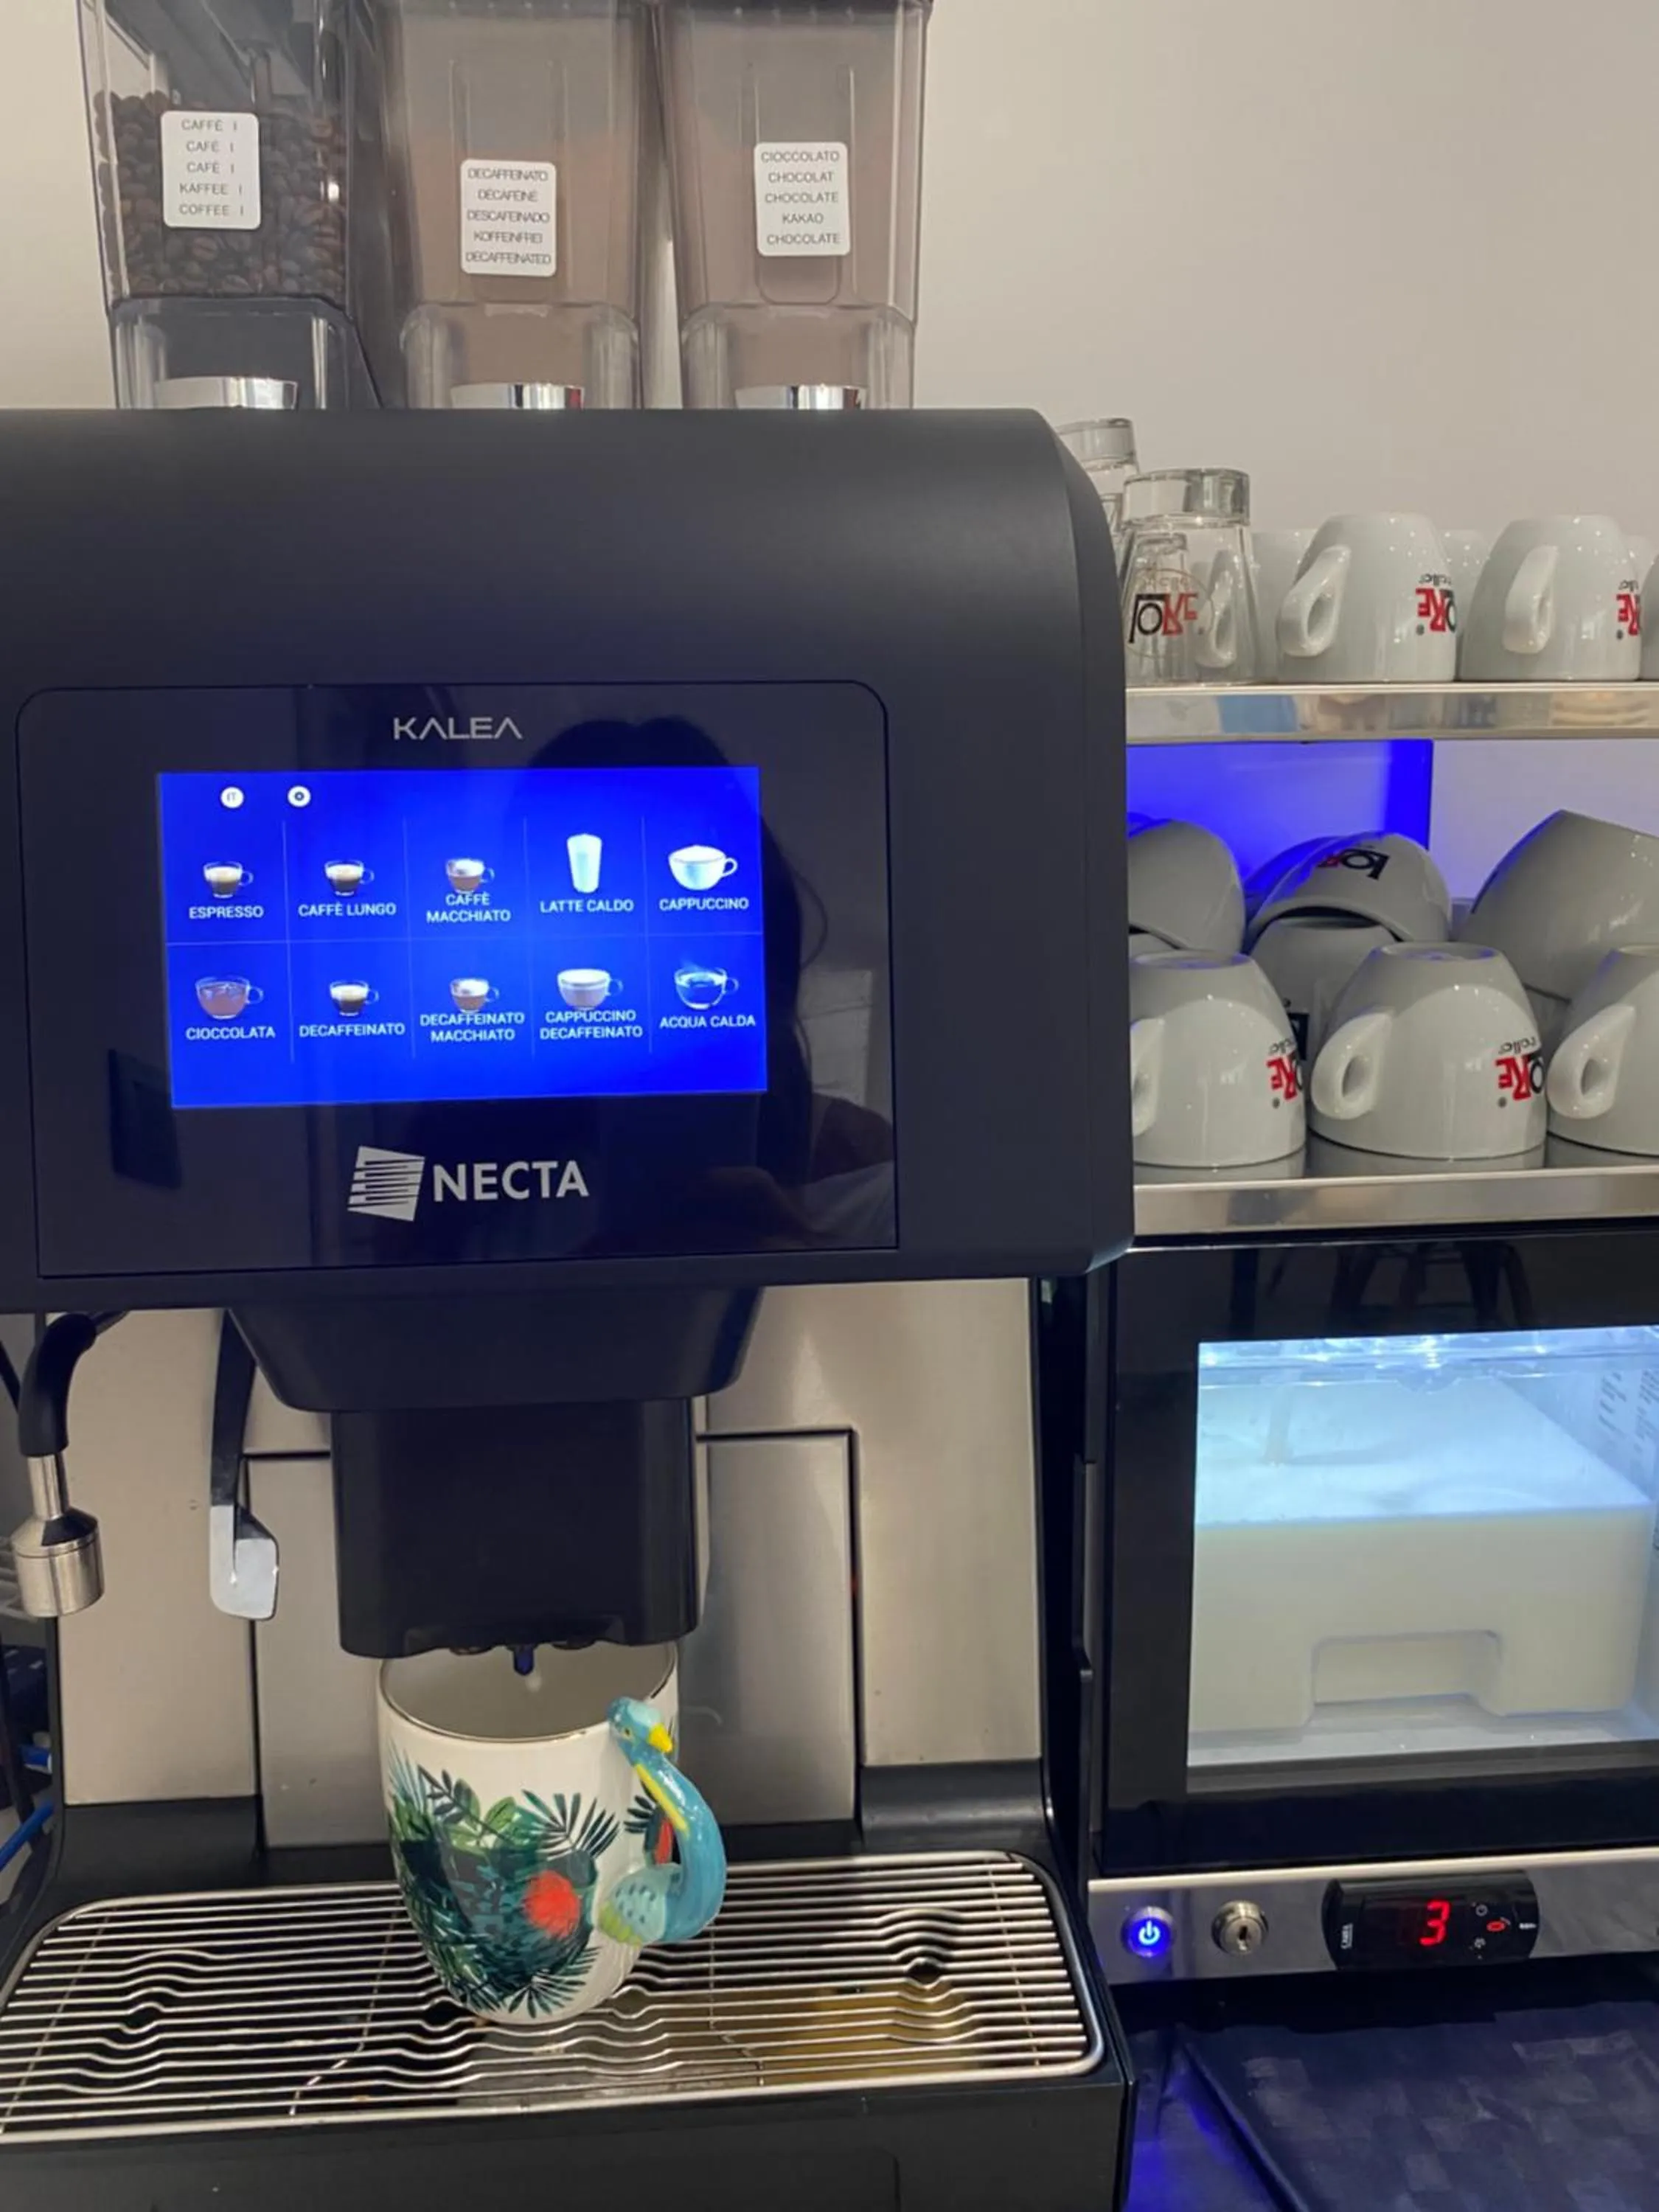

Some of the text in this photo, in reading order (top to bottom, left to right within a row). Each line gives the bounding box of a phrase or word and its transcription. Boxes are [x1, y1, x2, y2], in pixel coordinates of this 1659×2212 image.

[760, 150, 840, 163] CIOCCOLATO
[768, 171, 833, 183] CHOCOLAT
[179, 182, 229, 195] KAFFEE
[765, 192, 839, 204] CHOCOLATE
[178, 204, 230, 216] COFFEE
[782, 212, 824, 224] KAKAO
[767, 233, 840, 245] CHOCOLATE
[393, 717, 524, 740] KALEA
[347, 902, 397, 916] LUNGO
[540, 898, 635, 914] LATTE CALDO
[659, 897, 750, 911] CAPPUCCINO
[189, 905, 264, 919] ESPRESSO
[426, 909, 511, 923] MACCHIATO
[420, 1011, 525, 1027] DECAFFEINATO
[545, 1009, 636, 1024] CAPPUCCINO
[659, 1014, 757, 1030] ACQUA CALDA
[186, 1026, 276, 1040] CIOCCOLATA
[299, 1023, 406, 1037] DECAFFEINATO
[430, 1028, 516, 1043] MACCHIATO
[540, 1026, 644, 1040] DECAFFEINATO
[433, 1160, 590, 1202] NECTA
[1419, 1899, 1450, 1947] 3
